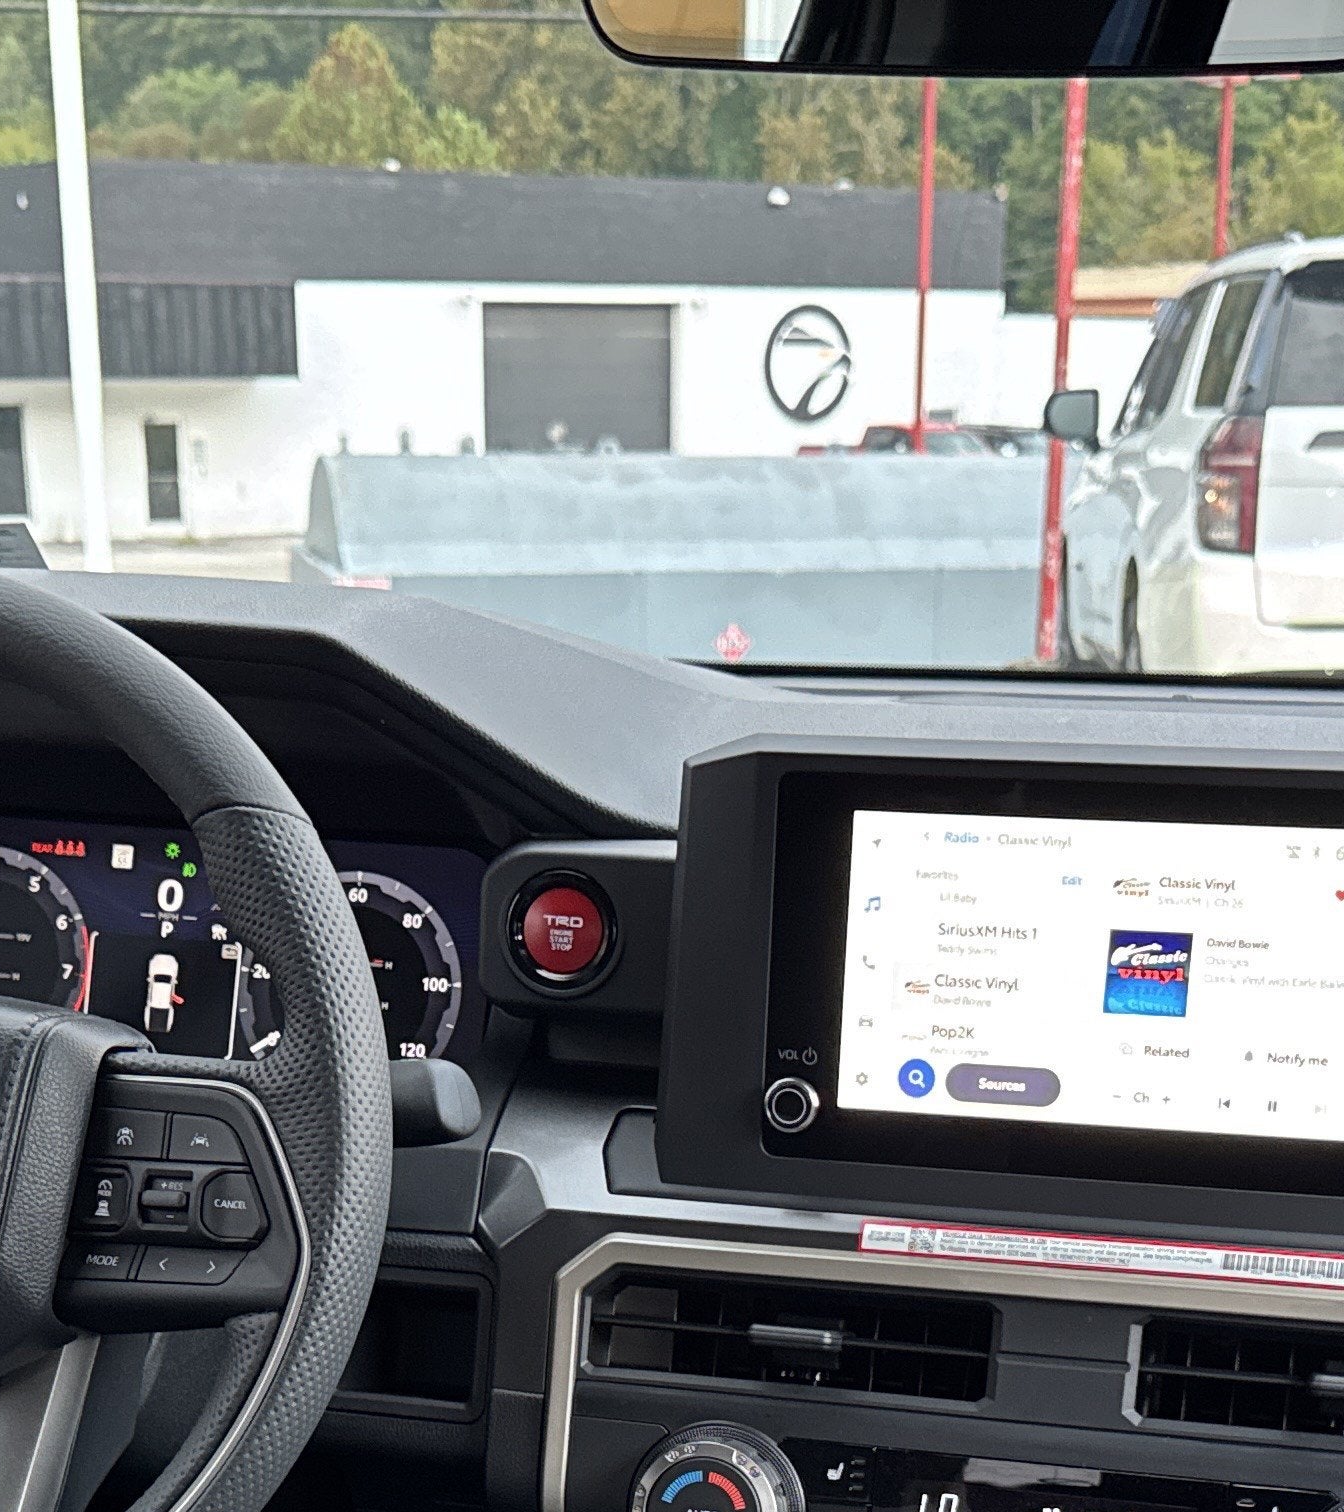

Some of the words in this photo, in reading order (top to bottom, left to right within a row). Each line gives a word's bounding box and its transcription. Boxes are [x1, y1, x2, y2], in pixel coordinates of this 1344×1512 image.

[944, 831, 979, 844] Radio
[28, 876, 41, 893] 5
[1159, 877, 1201, 890] Classic
[1205, 878, 1236, 891] Vinyl
[157, 879, 184, 912] 0
[348, 888, 368, 903] 60
[55, 915, 68, 931] 6
[402, 913, 423, 929] 80
[542, 913, 584, 929] TRD
[160, 921, 174, 938] P
[938, 922, 997, 938] SiriusXM
[1001, 926, 1028, 940] Hits
[1031, 927, 1038, 940] 1
[1206, 939, 1236, 949] David
[1238, 940, 1270, 950] Bowie
[1131, 950, 1188, 966] Classic
[62, 963, 73, 980] 7
[1117, 965, 1185, 985] vinyl
[422, 977, 448, 993] 100
[934, 973, 983, 990] Classic
[985, 977, 1019, 993] Vinyl
[931, 1025, 975, 1041] Pop2K
[399, 1043, 426, 1058] 120
[777, 1048, 799, 1060] VOL
[1144, 1045, 1190, 1058] Related
[1267, 1052, 1305, 1067] Notify
[1308, 1056, 1328, 1066] me
[978, 1077, 1026, 1092] Sources
[1133, 1092, 1150, 1103] Ch
[214, 1199, 247, 1210] CANCEL
[86, 1253, 119, 1267] MODE
